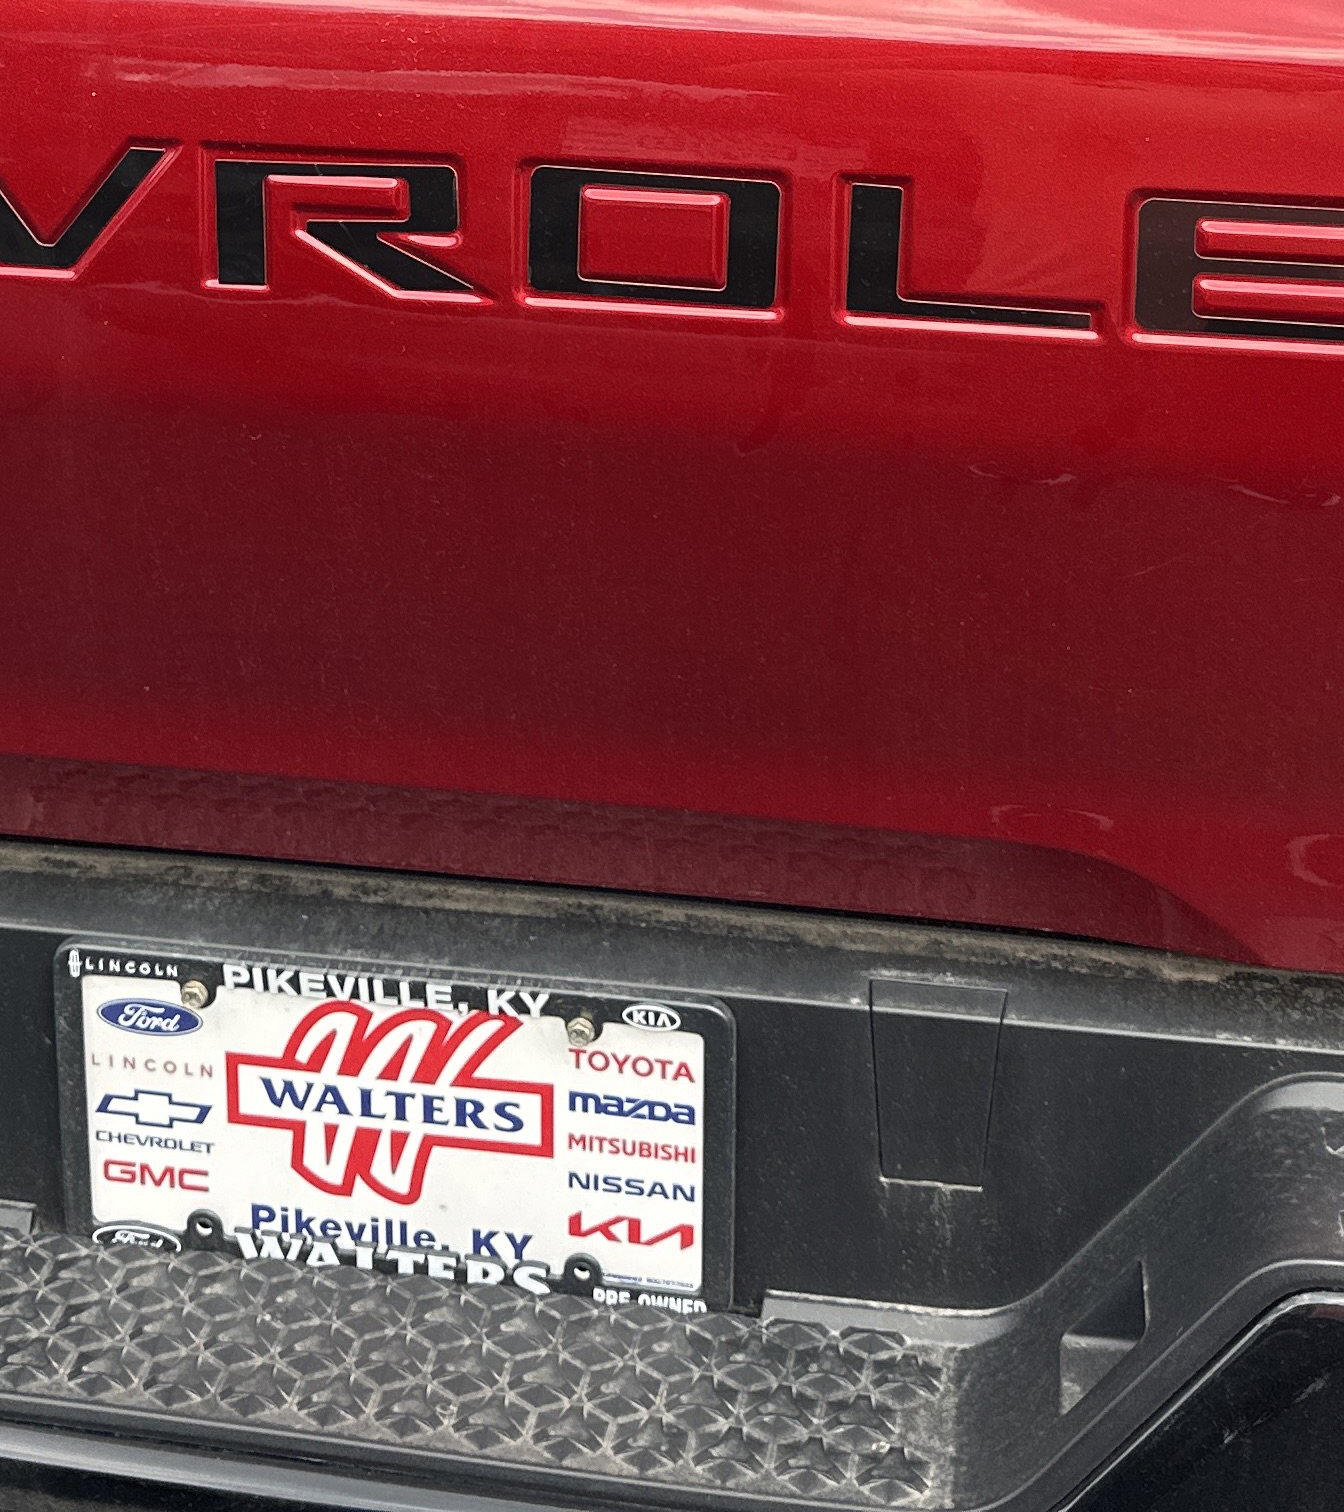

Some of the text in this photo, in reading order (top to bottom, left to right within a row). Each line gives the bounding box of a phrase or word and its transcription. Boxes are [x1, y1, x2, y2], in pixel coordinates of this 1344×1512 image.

[84, 956, 179, 977] LINCOLN
[221, 963, 550, 1018] PIKEVILLE, KY
[117, 1002, 181, 1032] Ford
[632, 1010, 672, 1027] KIA
[91, 1053, 214, 1078] LINCOLN
[567, 1047, 695, 1083] TOYOTA
[259, 1075, 525, 1133] WALTERS
[95, 1129, 215, 1154] CHEVROLET
[567, 1132, 696, 1164] MITSUBISHI
[103, 1158, 209, 1192] GMC
[567, 1171, 695, 1202] NISSAN
[471, 1228, 534, 1261] KY
